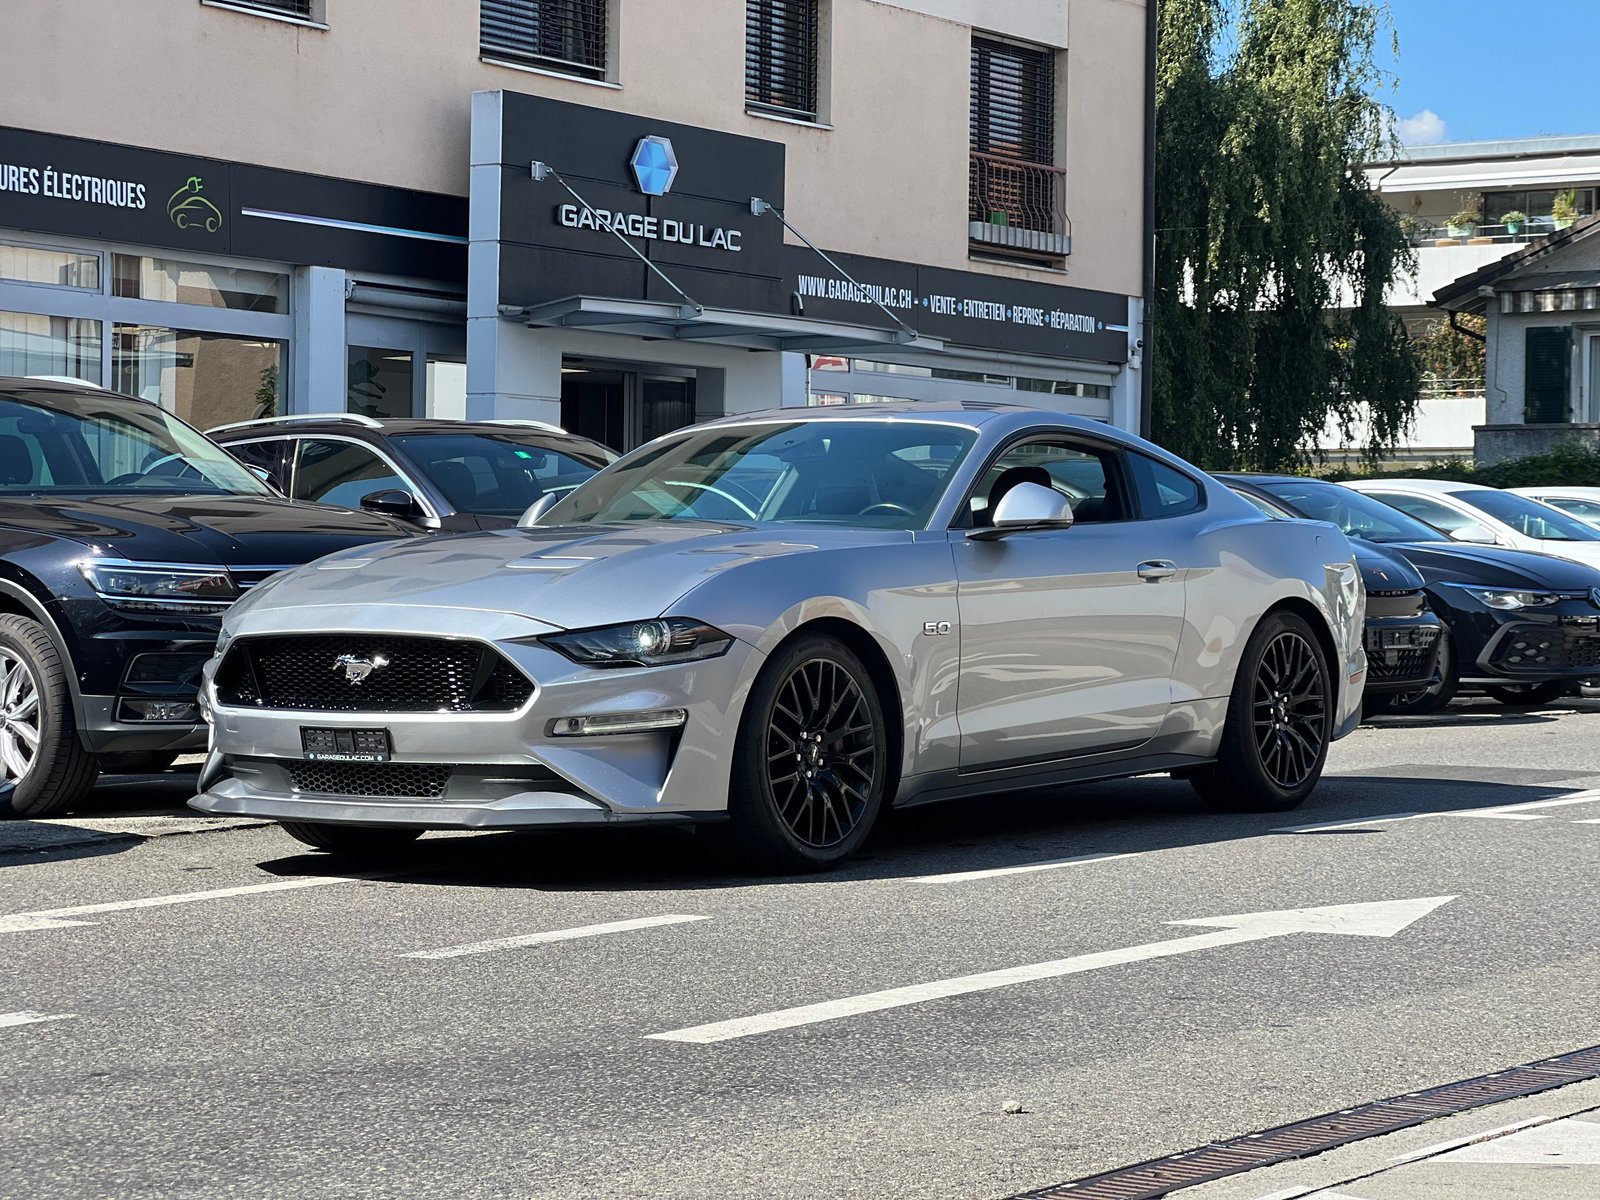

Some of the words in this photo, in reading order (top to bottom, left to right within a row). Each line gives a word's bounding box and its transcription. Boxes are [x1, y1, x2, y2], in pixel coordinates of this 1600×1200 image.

[0, 163, 40, 195] URES
[43, 166, 146, 209] ÉLECTRIQUES
[559, 203, 657, 240] GARAGE
[663, 219, 694, 244] DU
[699, 225, 742, 252] LAC
[798, 275, 912, 309] WWW.GARAGEDULAC.CH
[929, 294, 957, 315] VENTE
[963, 299, 1005, 322] ENTRETIEN
[1012, 305, 1044, 327] REPRISE
[1050, 308, 1095, 333] RÉPARATION
[316, 753, 375, 761] GARAGEDULAC.COM
